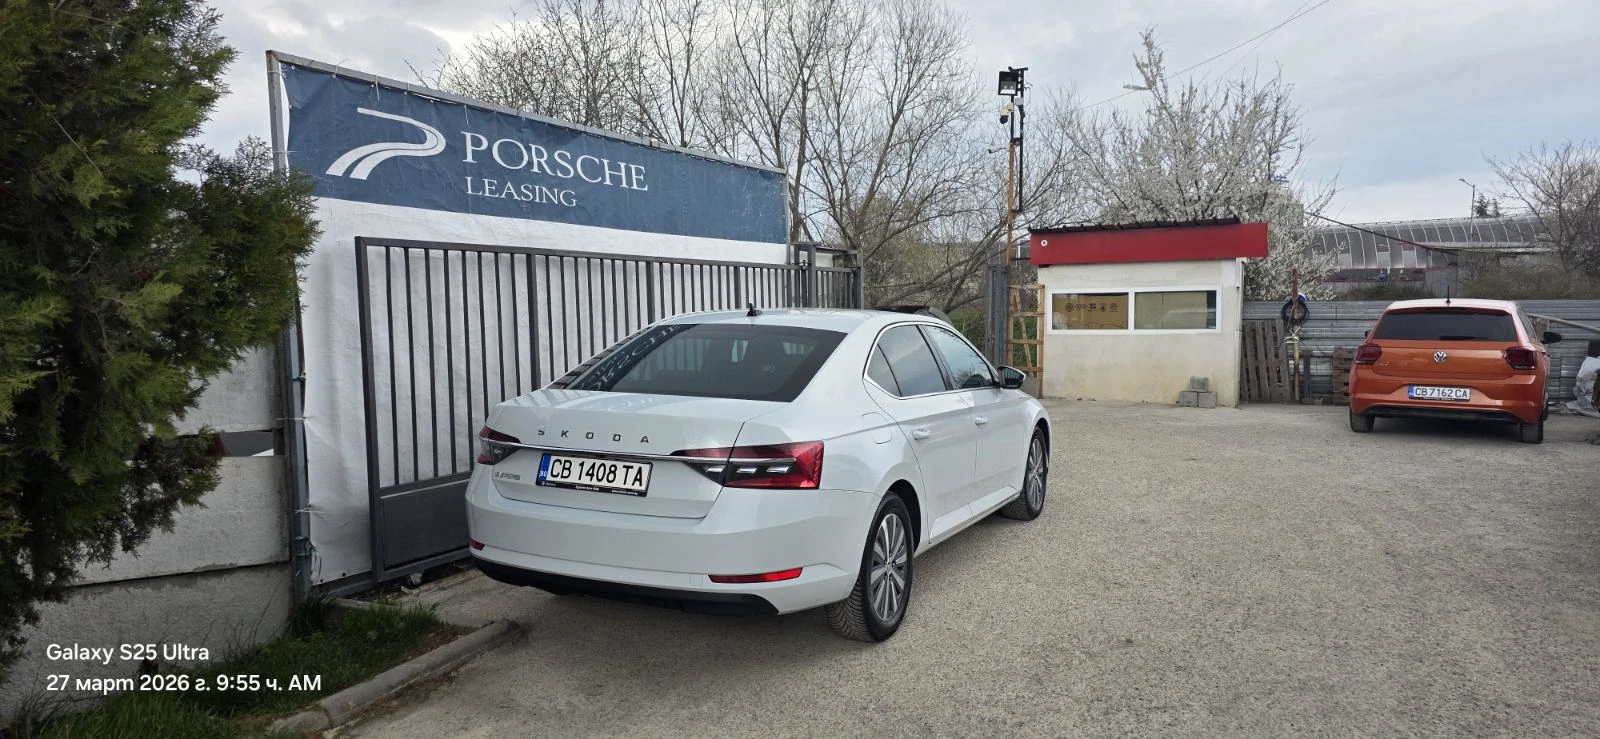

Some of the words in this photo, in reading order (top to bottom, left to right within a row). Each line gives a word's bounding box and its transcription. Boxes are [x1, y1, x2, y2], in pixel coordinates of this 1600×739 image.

[460, 131, 648, 192] PORSCHE
[465, 176, 577, 207] LEASING
[1415, 387, 1427, 397] CB
[1429, 387, 1453, 398] 7162
[1455, 388, 1468, 398] CA
[550, 458, 572, 479] CB
[578, 461, 618, 484] 1408
[622, 464, 643, 487] TA
